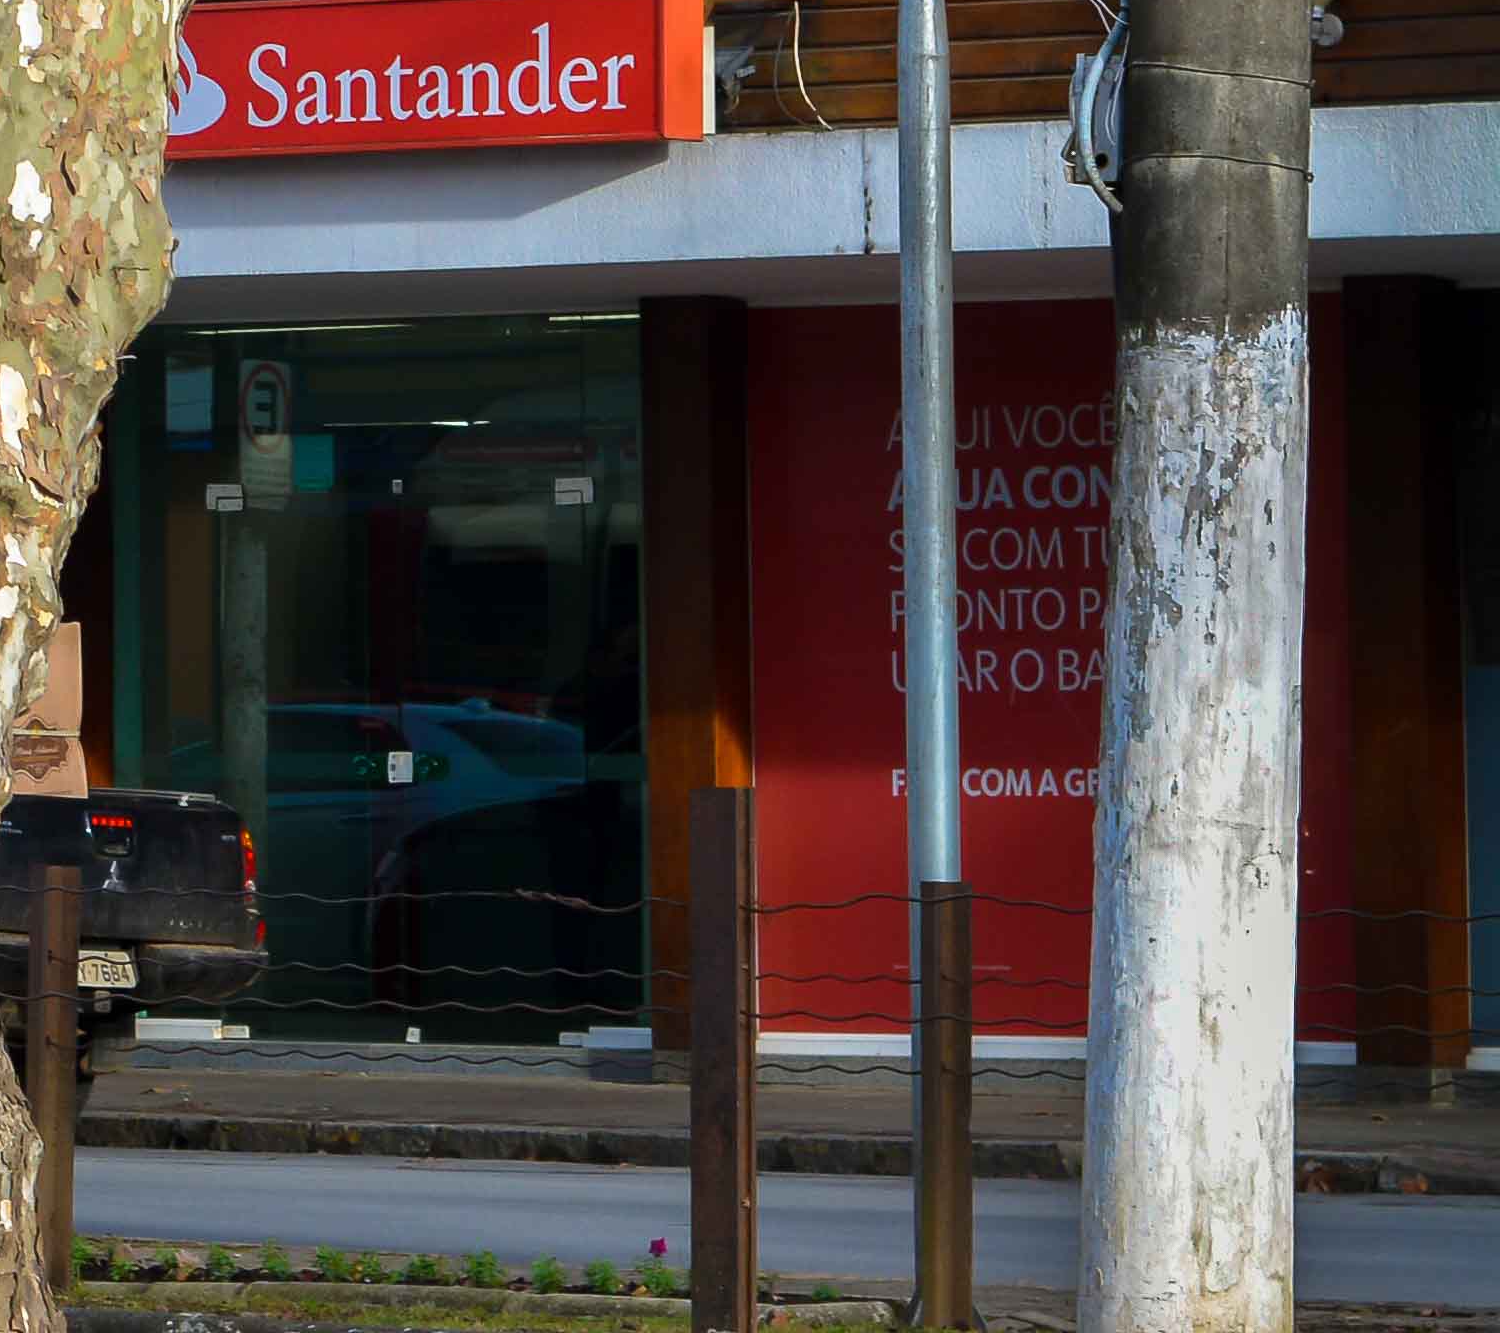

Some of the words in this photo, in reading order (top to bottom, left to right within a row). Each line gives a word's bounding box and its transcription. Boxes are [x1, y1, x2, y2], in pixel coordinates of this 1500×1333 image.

[246, 21, 636, 129] Santander
[963, 527, 1065, 572] COM
[1010, 647, 1045, 693] O
[961, 767, 1033, 798] COM
[1037, 768, 1060, 797] A
